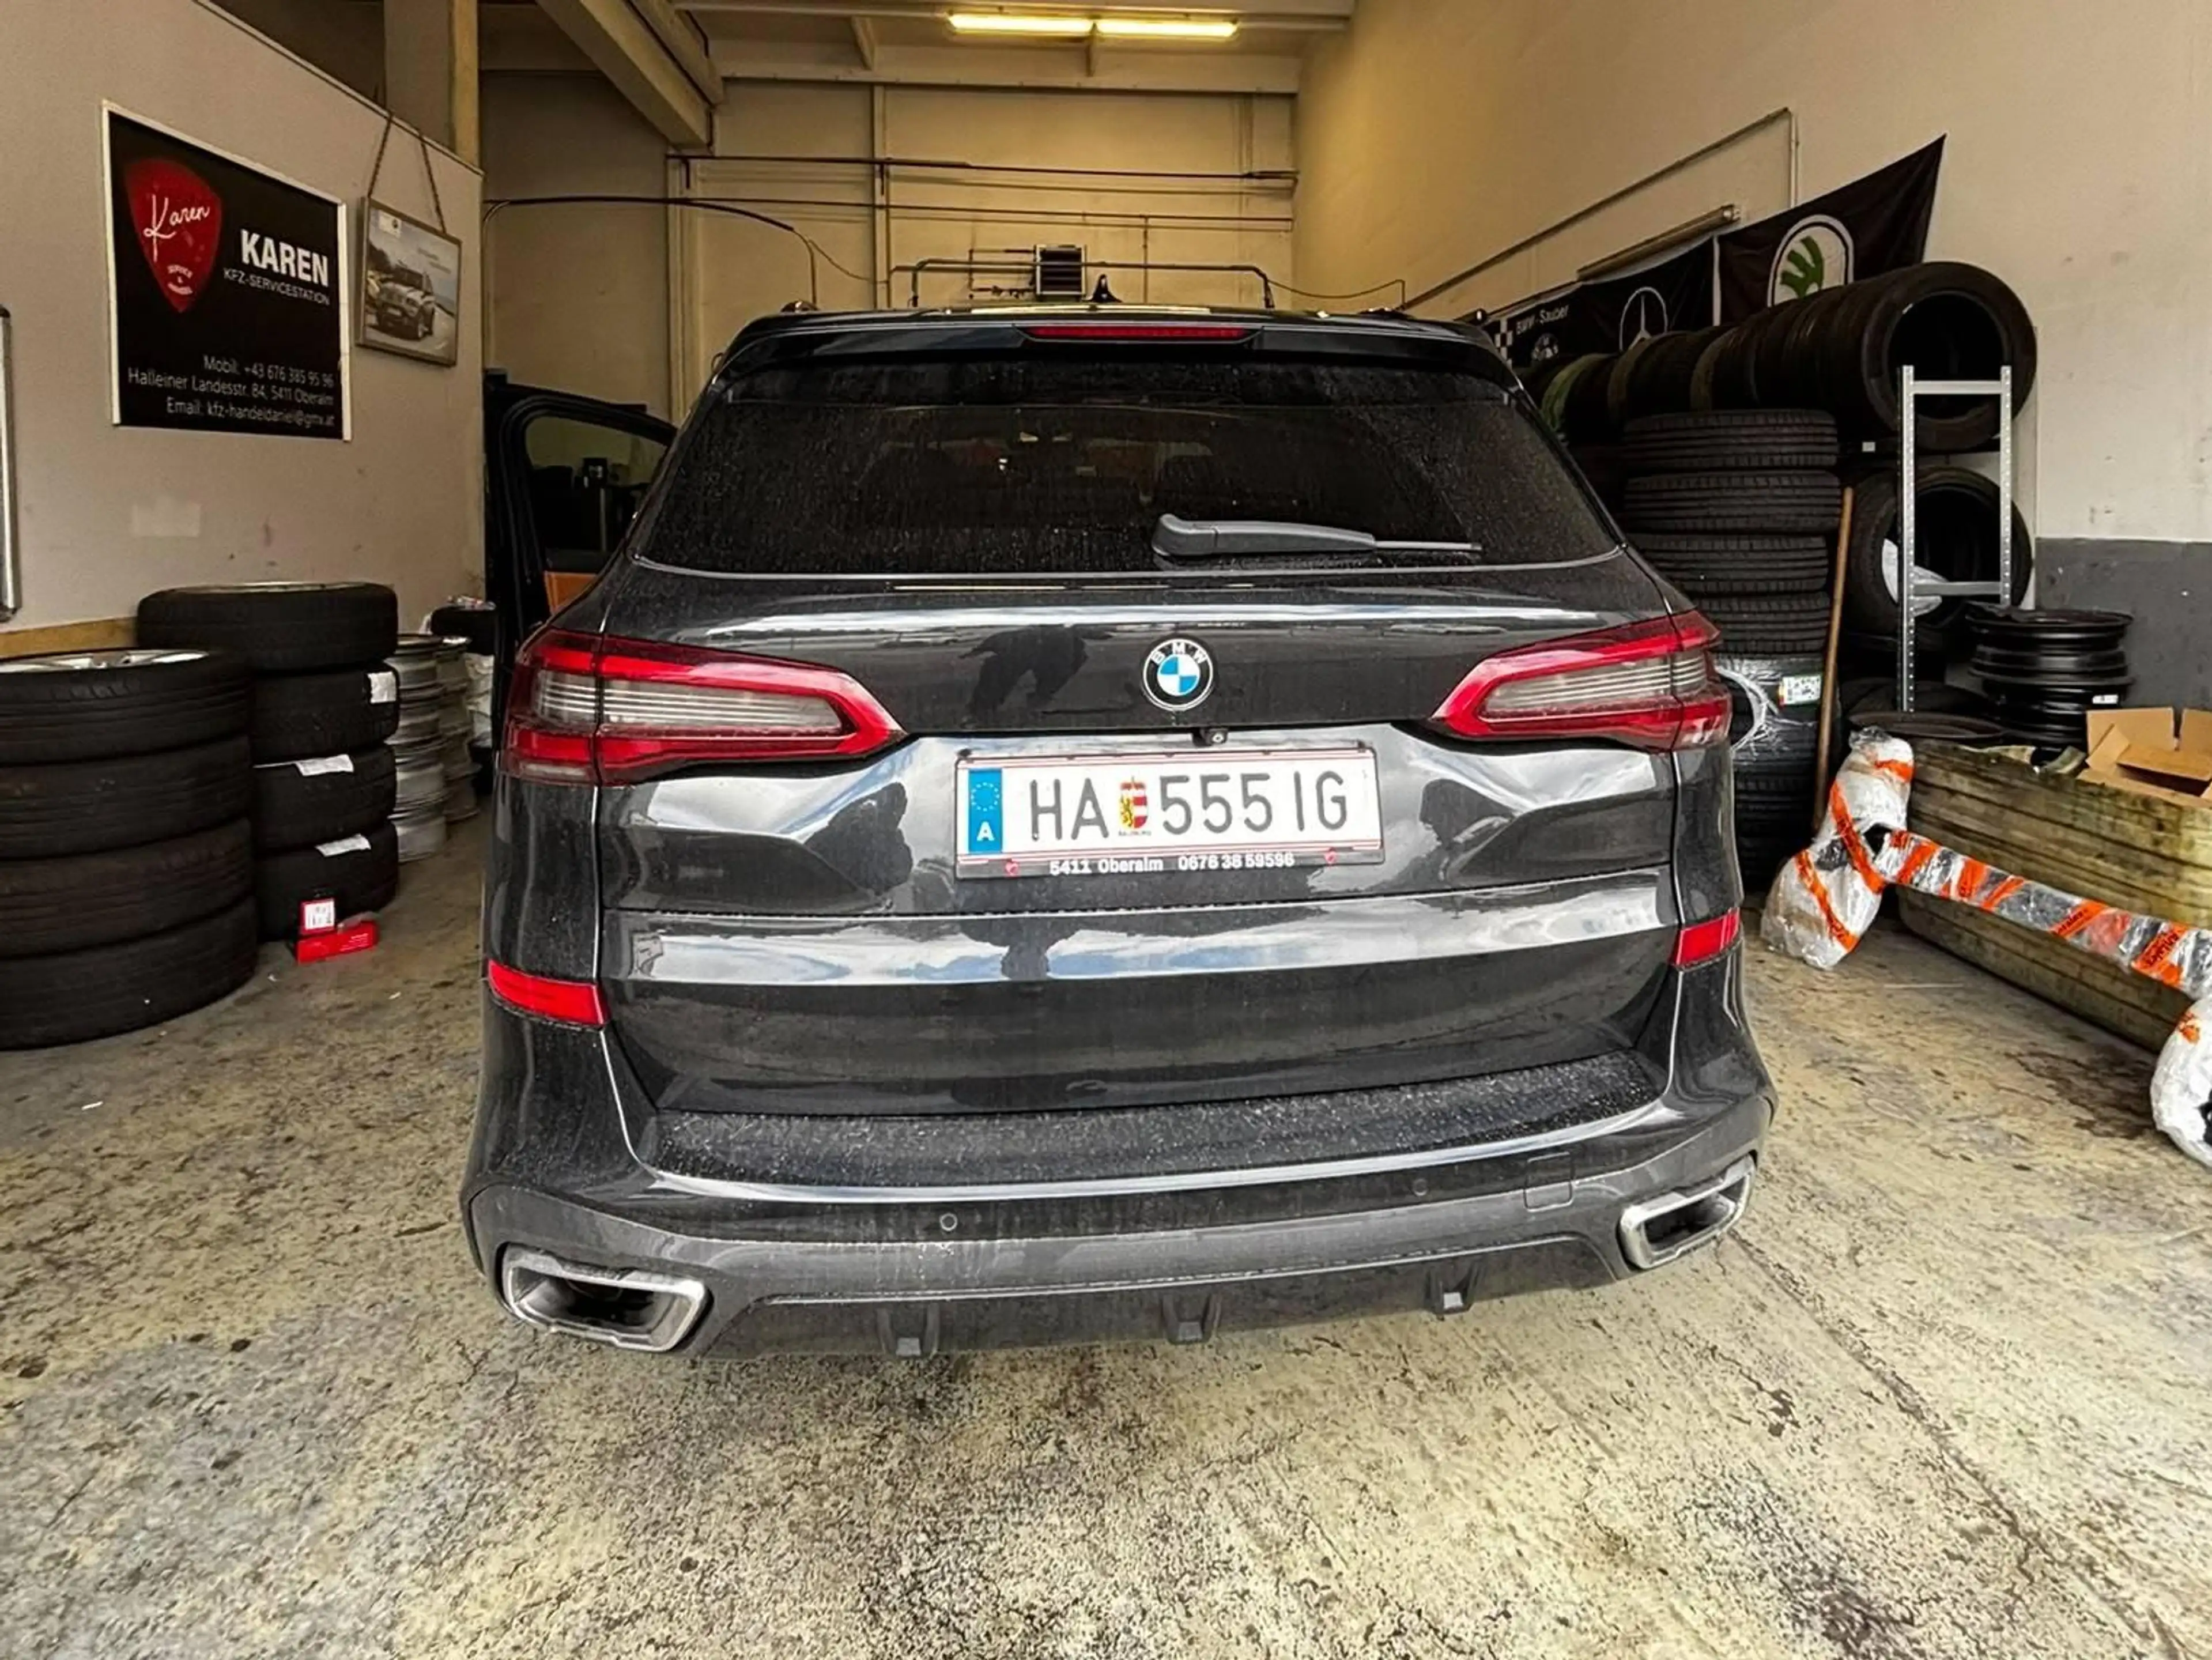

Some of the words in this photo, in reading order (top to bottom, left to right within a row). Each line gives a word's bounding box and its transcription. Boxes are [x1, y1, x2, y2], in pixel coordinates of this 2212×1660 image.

[144, 194, 210, 263] Karen
[241, 228, 329, 288] KAREN
[976, 820, 995, 842] A
[1030, 778, 1109, 842] HA
[1160, 773, 1273, 835] 555
[1293, 770, 1347, 832] IG
[1050, 859, 1092, 876] 5411
[1098, 857, 1164, 874] Oberalm
